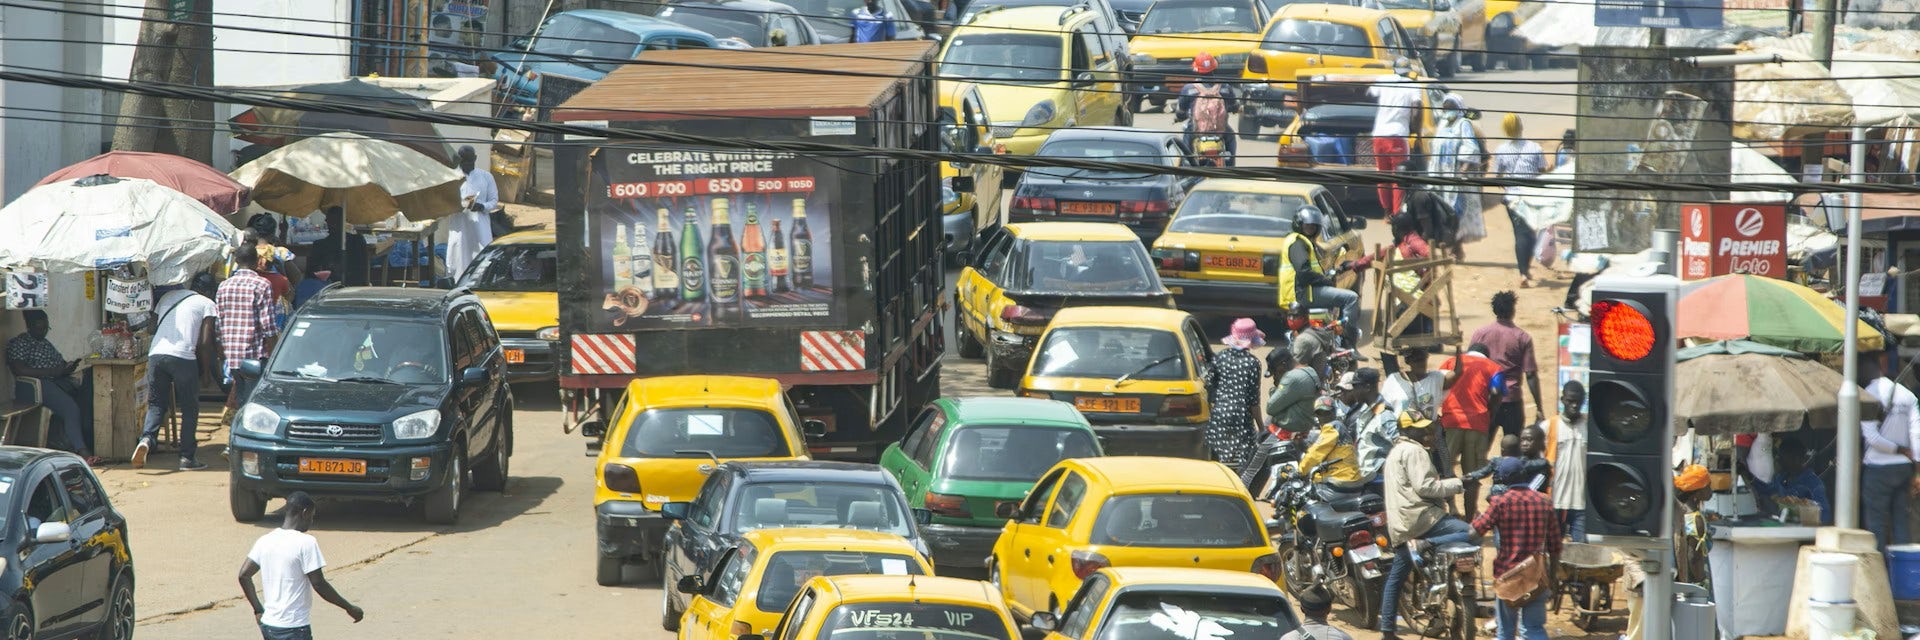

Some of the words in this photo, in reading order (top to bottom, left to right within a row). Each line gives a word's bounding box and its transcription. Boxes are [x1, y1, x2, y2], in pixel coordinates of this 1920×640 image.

[627, 151, 711, 164] CELEBRATE
[653, 164, 682, 175] THE
[684, 163, 728, 174] RIGHT
[730, 161, 773, 172] PRICE
[614, 184, 648, 196] 600
[657, 182, 687, 194] 700
[708, 179, 744, 192] 650
[757, 180, 783, 190] 500
[787, 179, 814, 189] 1050
[1718, 237, 1780, 256] PREMIER
[1729, 256, 1770, 275] Loto
[106, 297, 130, 309] Orange
[136, 299, 151, 307] MTN
[309, 460, 324, 472] LT
[325, 461, 345, 473] 871
[944, 610, 974, 627] VIP
